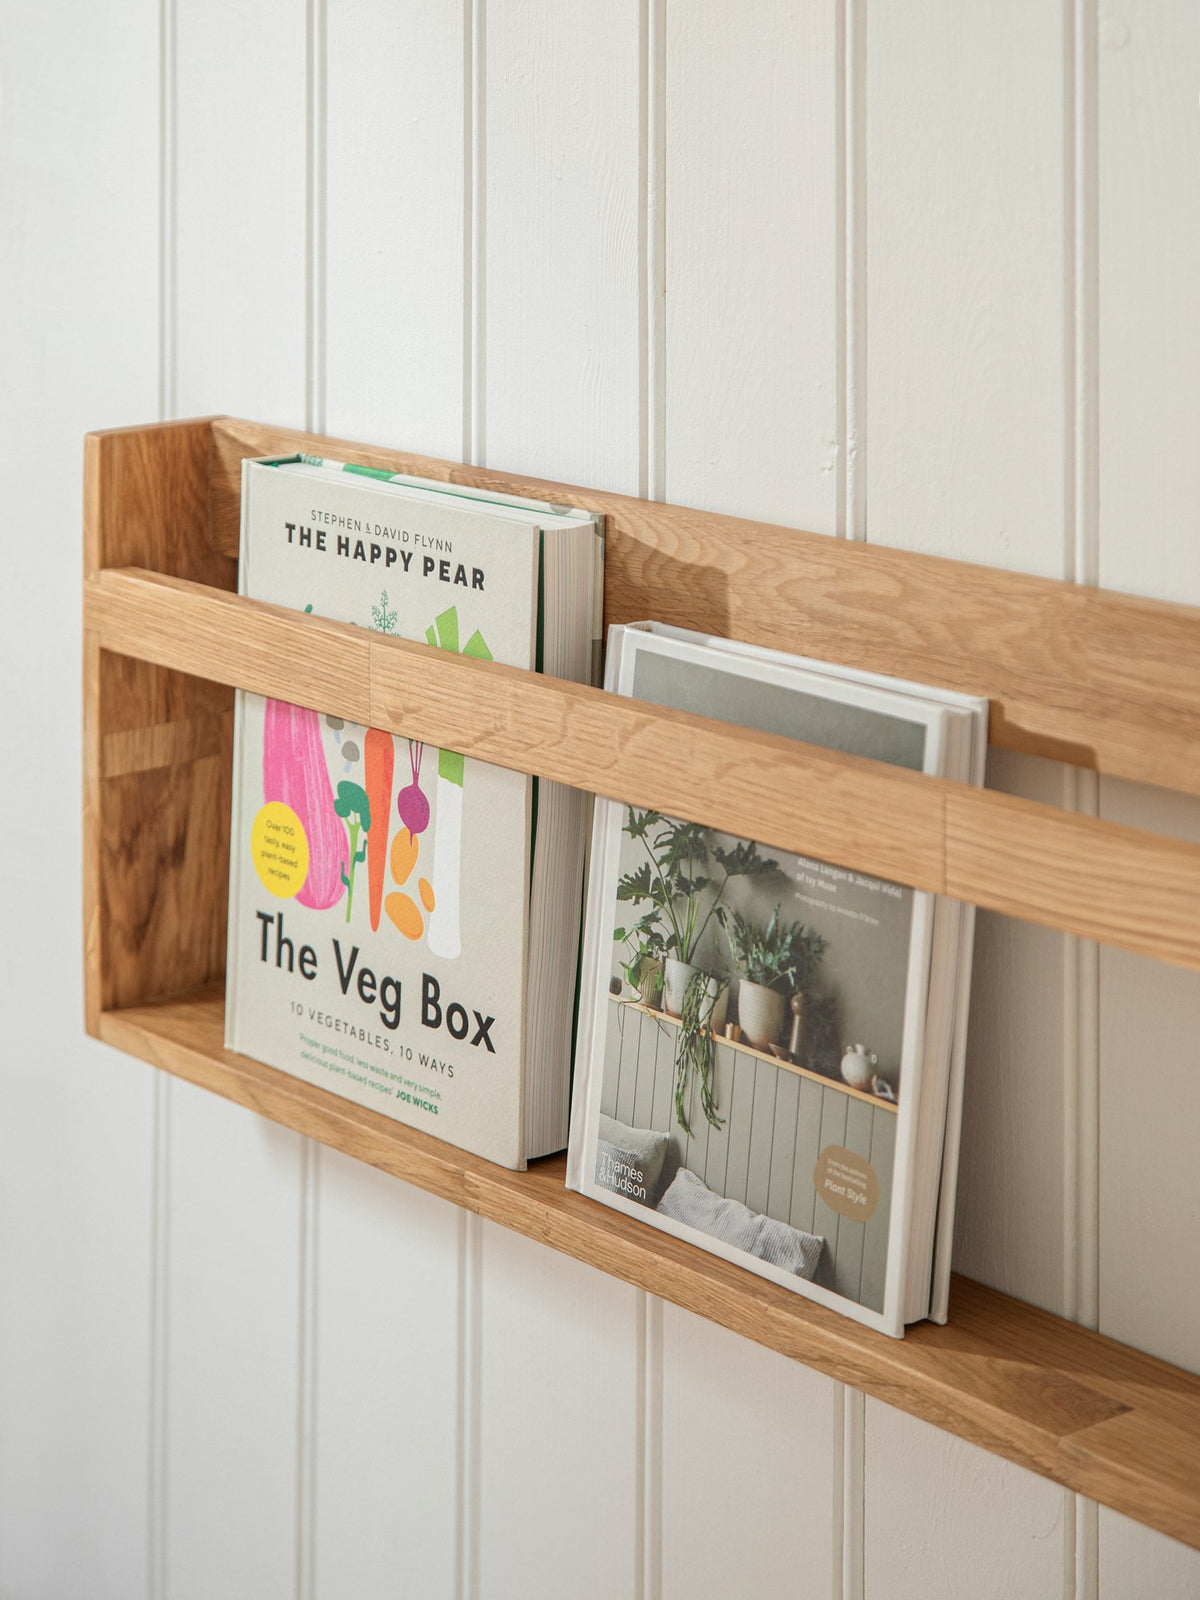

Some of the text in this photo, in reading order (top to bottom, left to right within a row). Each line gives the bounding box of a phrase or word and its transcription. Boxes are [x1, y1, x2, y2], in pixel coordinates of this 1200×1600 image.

[310, 509, 453, 553] STEPHEN & DAVID FLYNN
[285, 522, 485, 591] THE HAPPY PEAR
[266, 819, 295, 837] Over 100
[260, 849, 298, 869] plant-based
[281, 842, 296, 854] easy
[267, 867, 290, 881] recipes
[796, 872, 805, 882] of
[817, 878, 837, 892] Muse
[256, 910, 497, 1055] The Veg Box
[291, 1001, 455, 1079] 10 VEGETABLES, 10 WAYS
[301, 1050, 328, 1069] delicious
[329, 1060, 368, 1085] plant-based
[395, 1089, 411, 1104] JOE
[412, 1097, 439, 1115] WICKS
[322, 1041, 338, 1057] good
[356, 1056, 369, 1070] less
[370, 1064, 389, 1078] waste
[389, 1071, 403, 1084] and
[403, 1077, 418, 1092] very
[418, 1082, 442, 1101] simple,
[600, 1151, 644, 1183] Thames
[824, 1178, 867, 1205] Plant Style
